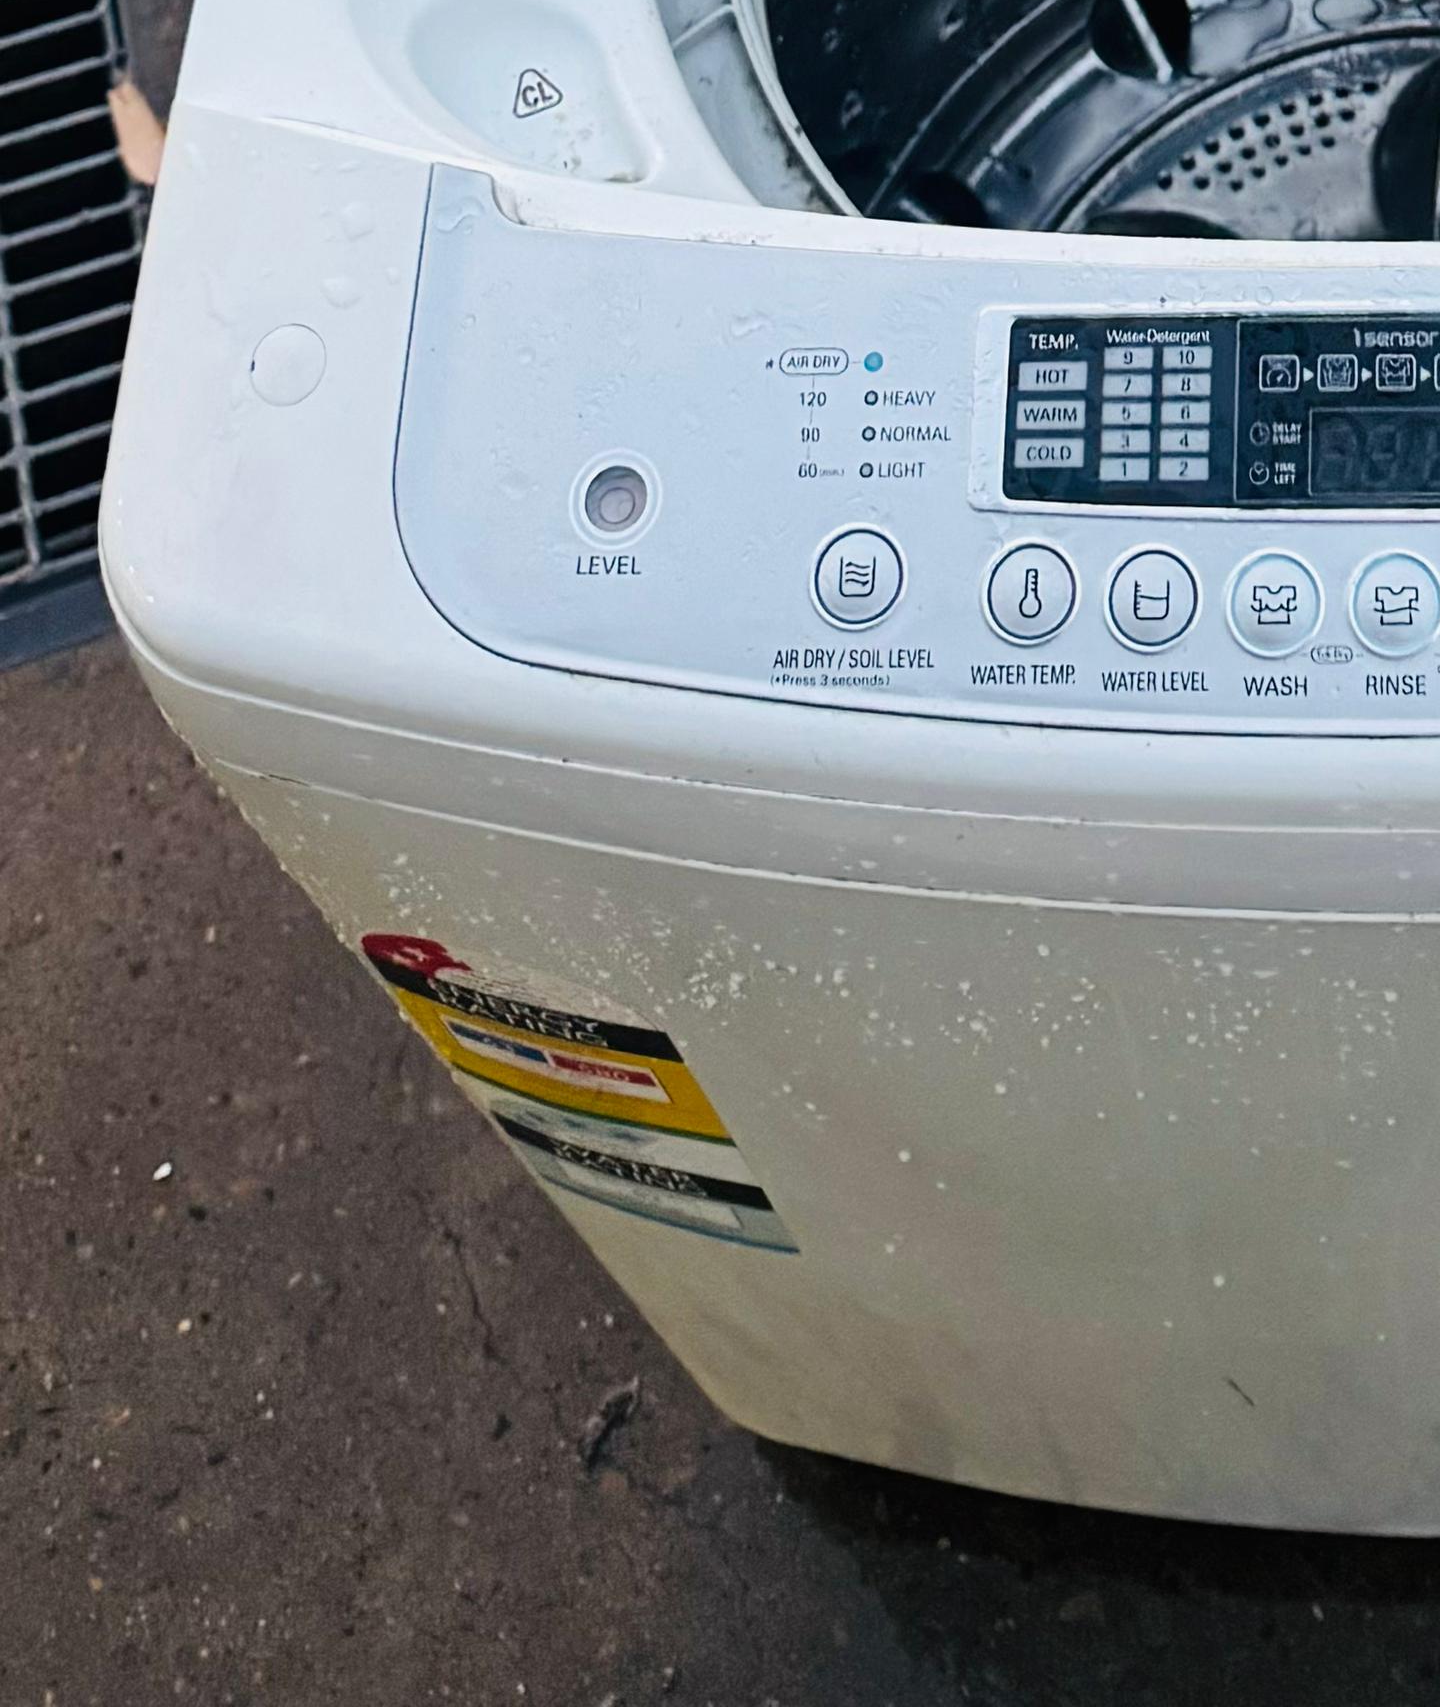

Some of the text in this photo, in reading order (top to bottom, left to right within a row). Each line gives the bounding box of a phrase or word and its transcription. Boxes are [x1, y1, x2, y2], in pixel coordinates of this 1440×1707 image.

[1028, 333, 1079, 351] TEMP.
[786, 355, 841, 370] AIR DRY
[1178, 349, 1196, 365] 10
[1034, 368, 1070, 385] HOT
[798, 391, 828, 408] 120
[882, 390, 937, 406] HEAVY
[1022, 407, 1078, 423] WARM
[880, 425, 952, 442] NORMAL
[1179, 433, 1190, 448] 4
[1026, 445, 1072, 462] COLD
[798, 462, 818, 478] 60
[877, 462, 927, 478] LIGHT
[1178, 461, 1189, 477] 2
[1274, 461, 1296, 473] TIME
[1274, 474, 1296, 485] LEFT
[575, 555, 643, 576] LEVEL
[772, 648, 800, 670] AIR
[803, 648, 836, 670] DRY
[848, 648, 885, 670] SOIL
[888, 648, 936, 670] LEVEL
[820, 674, 830, 688] 3
[970, 663, 1077, 686] WATER TEMP.
[1101, 670, 1210, 693] WATER LEVEL
[1242, 675, 1309, 697] WASH
[1365, 674, 1428, 697] RINSE
